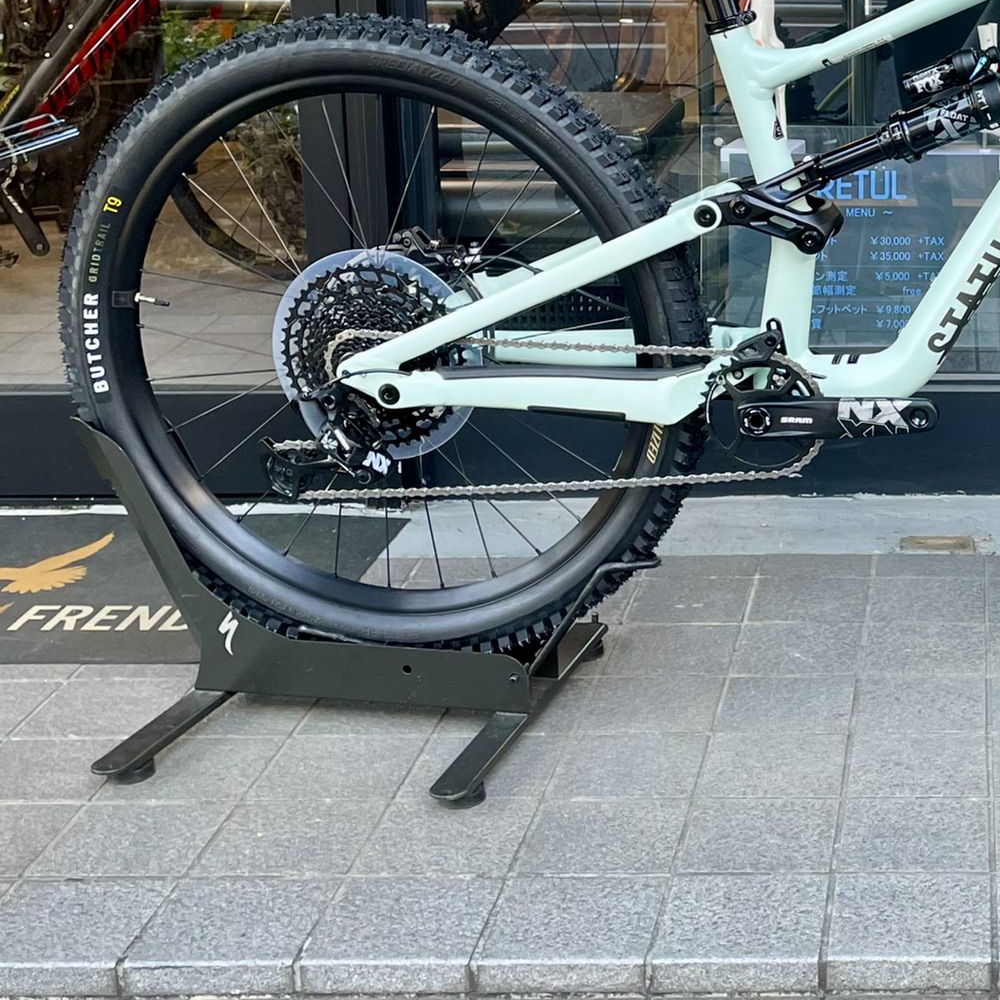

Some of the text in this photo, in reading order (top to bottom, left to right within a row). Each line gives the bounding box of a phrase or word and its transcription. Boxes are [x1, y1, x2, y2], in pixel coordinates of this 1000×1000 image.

[938, 109, 969, 122] FLOAT
[102, 195, 123, 215] T9
[845, 207, 876, 218] MENU
[918, 236, 945, 246] +TAX
[918, 251, 945, 261] +TAX
[902, 286, 922, 295] free
[876, 319, 908, 328] ¥7,00
[83, 292, 111, 394] BUTCHER
[780, 416, 813, 425] SRAM
